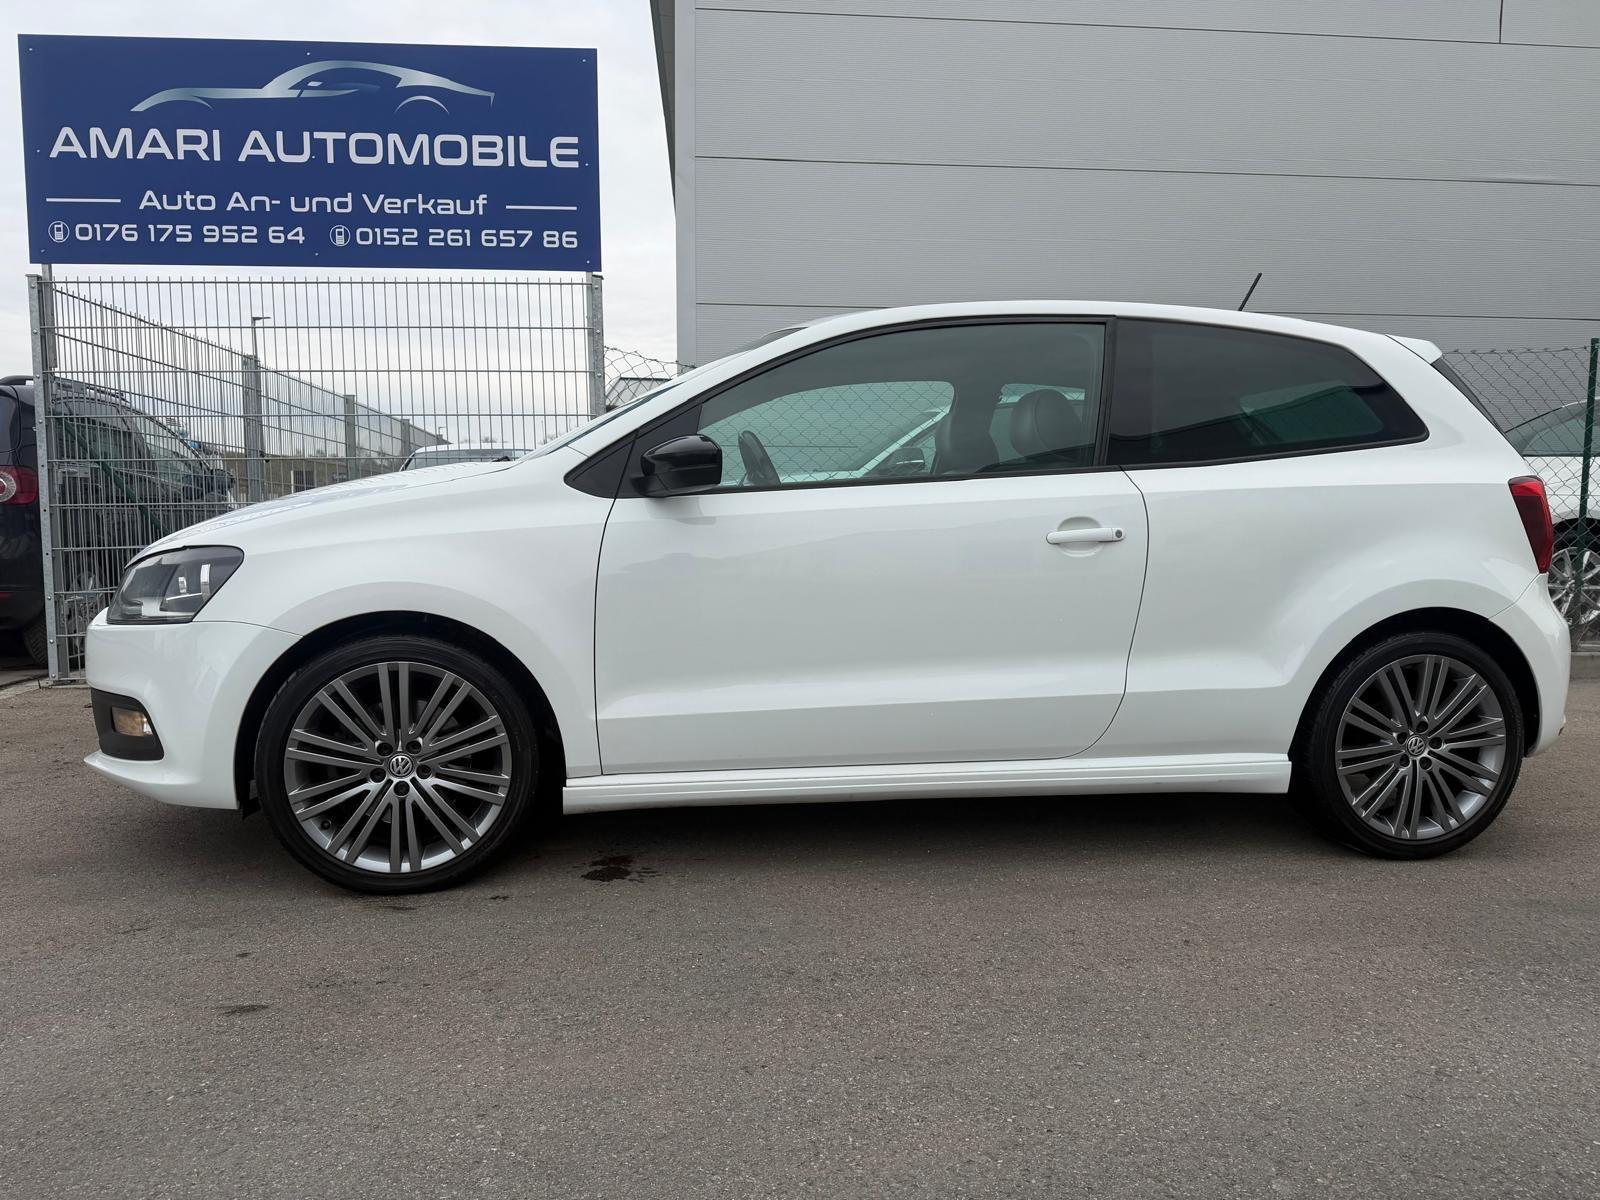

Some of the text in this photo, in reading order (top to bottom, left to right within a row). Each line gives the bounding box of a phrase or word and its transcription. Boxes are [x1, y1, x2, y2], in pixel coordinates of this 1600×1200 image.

[50, 127, 578, 167] AMARI AUTOMOBILE
[138, 190, 488, 216] Auto An- und Verkauf
[74, 223, 305, 245] 0176 175 952 64
[355, 227, 578, 249] 0152 261 657 86
